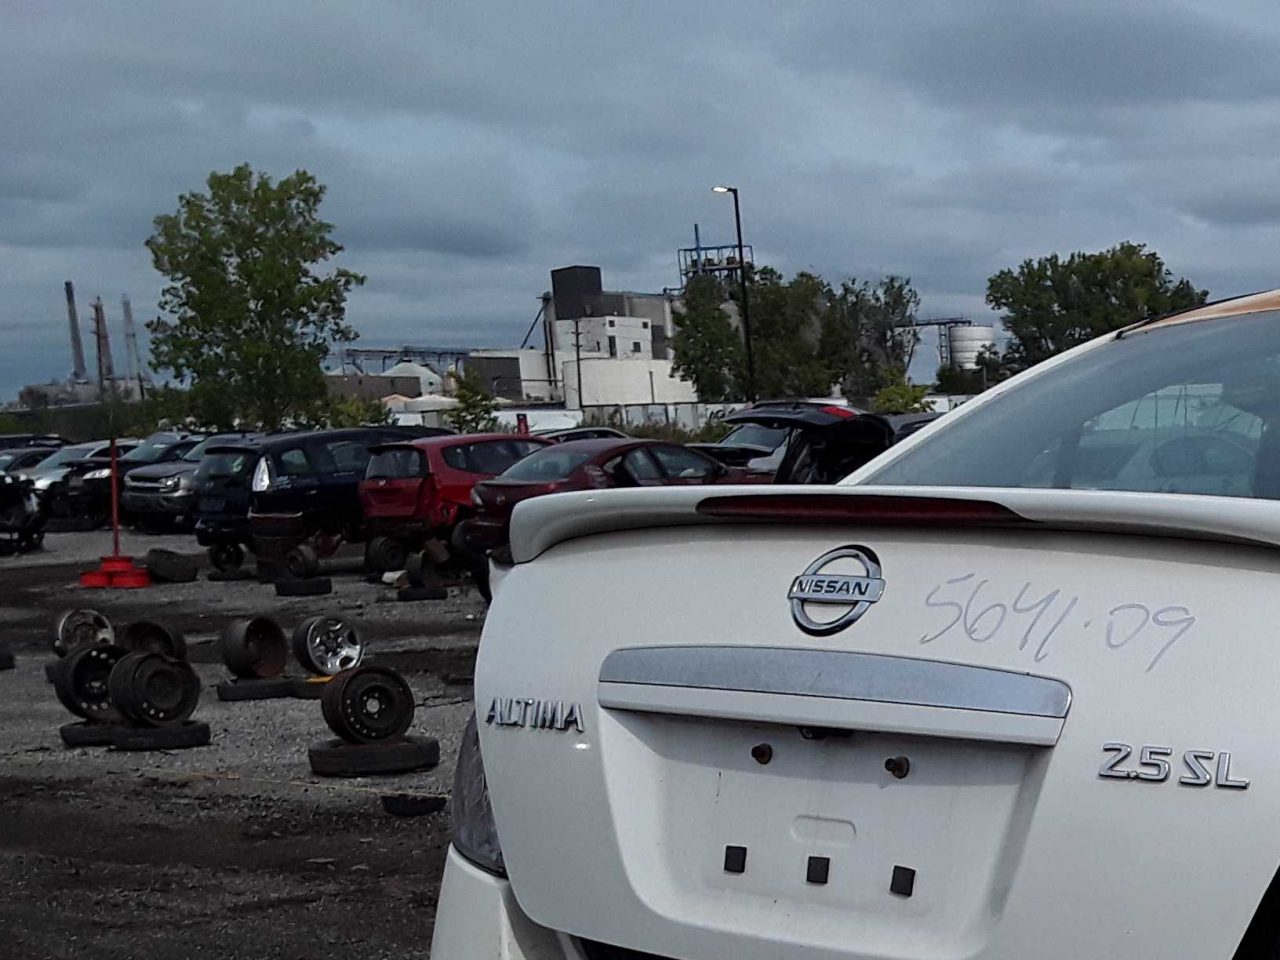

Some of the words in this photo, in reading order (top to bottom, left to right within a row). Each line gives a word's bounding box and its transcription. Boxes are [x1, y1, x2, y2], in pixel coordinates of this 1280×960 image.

[796, 579, 871, 596] NISSAN
[484, 697, 585, 734] ALTIMA
[1098, 741, 1173, 783] 2.5
[1178, 749, 1251, 790] SL
